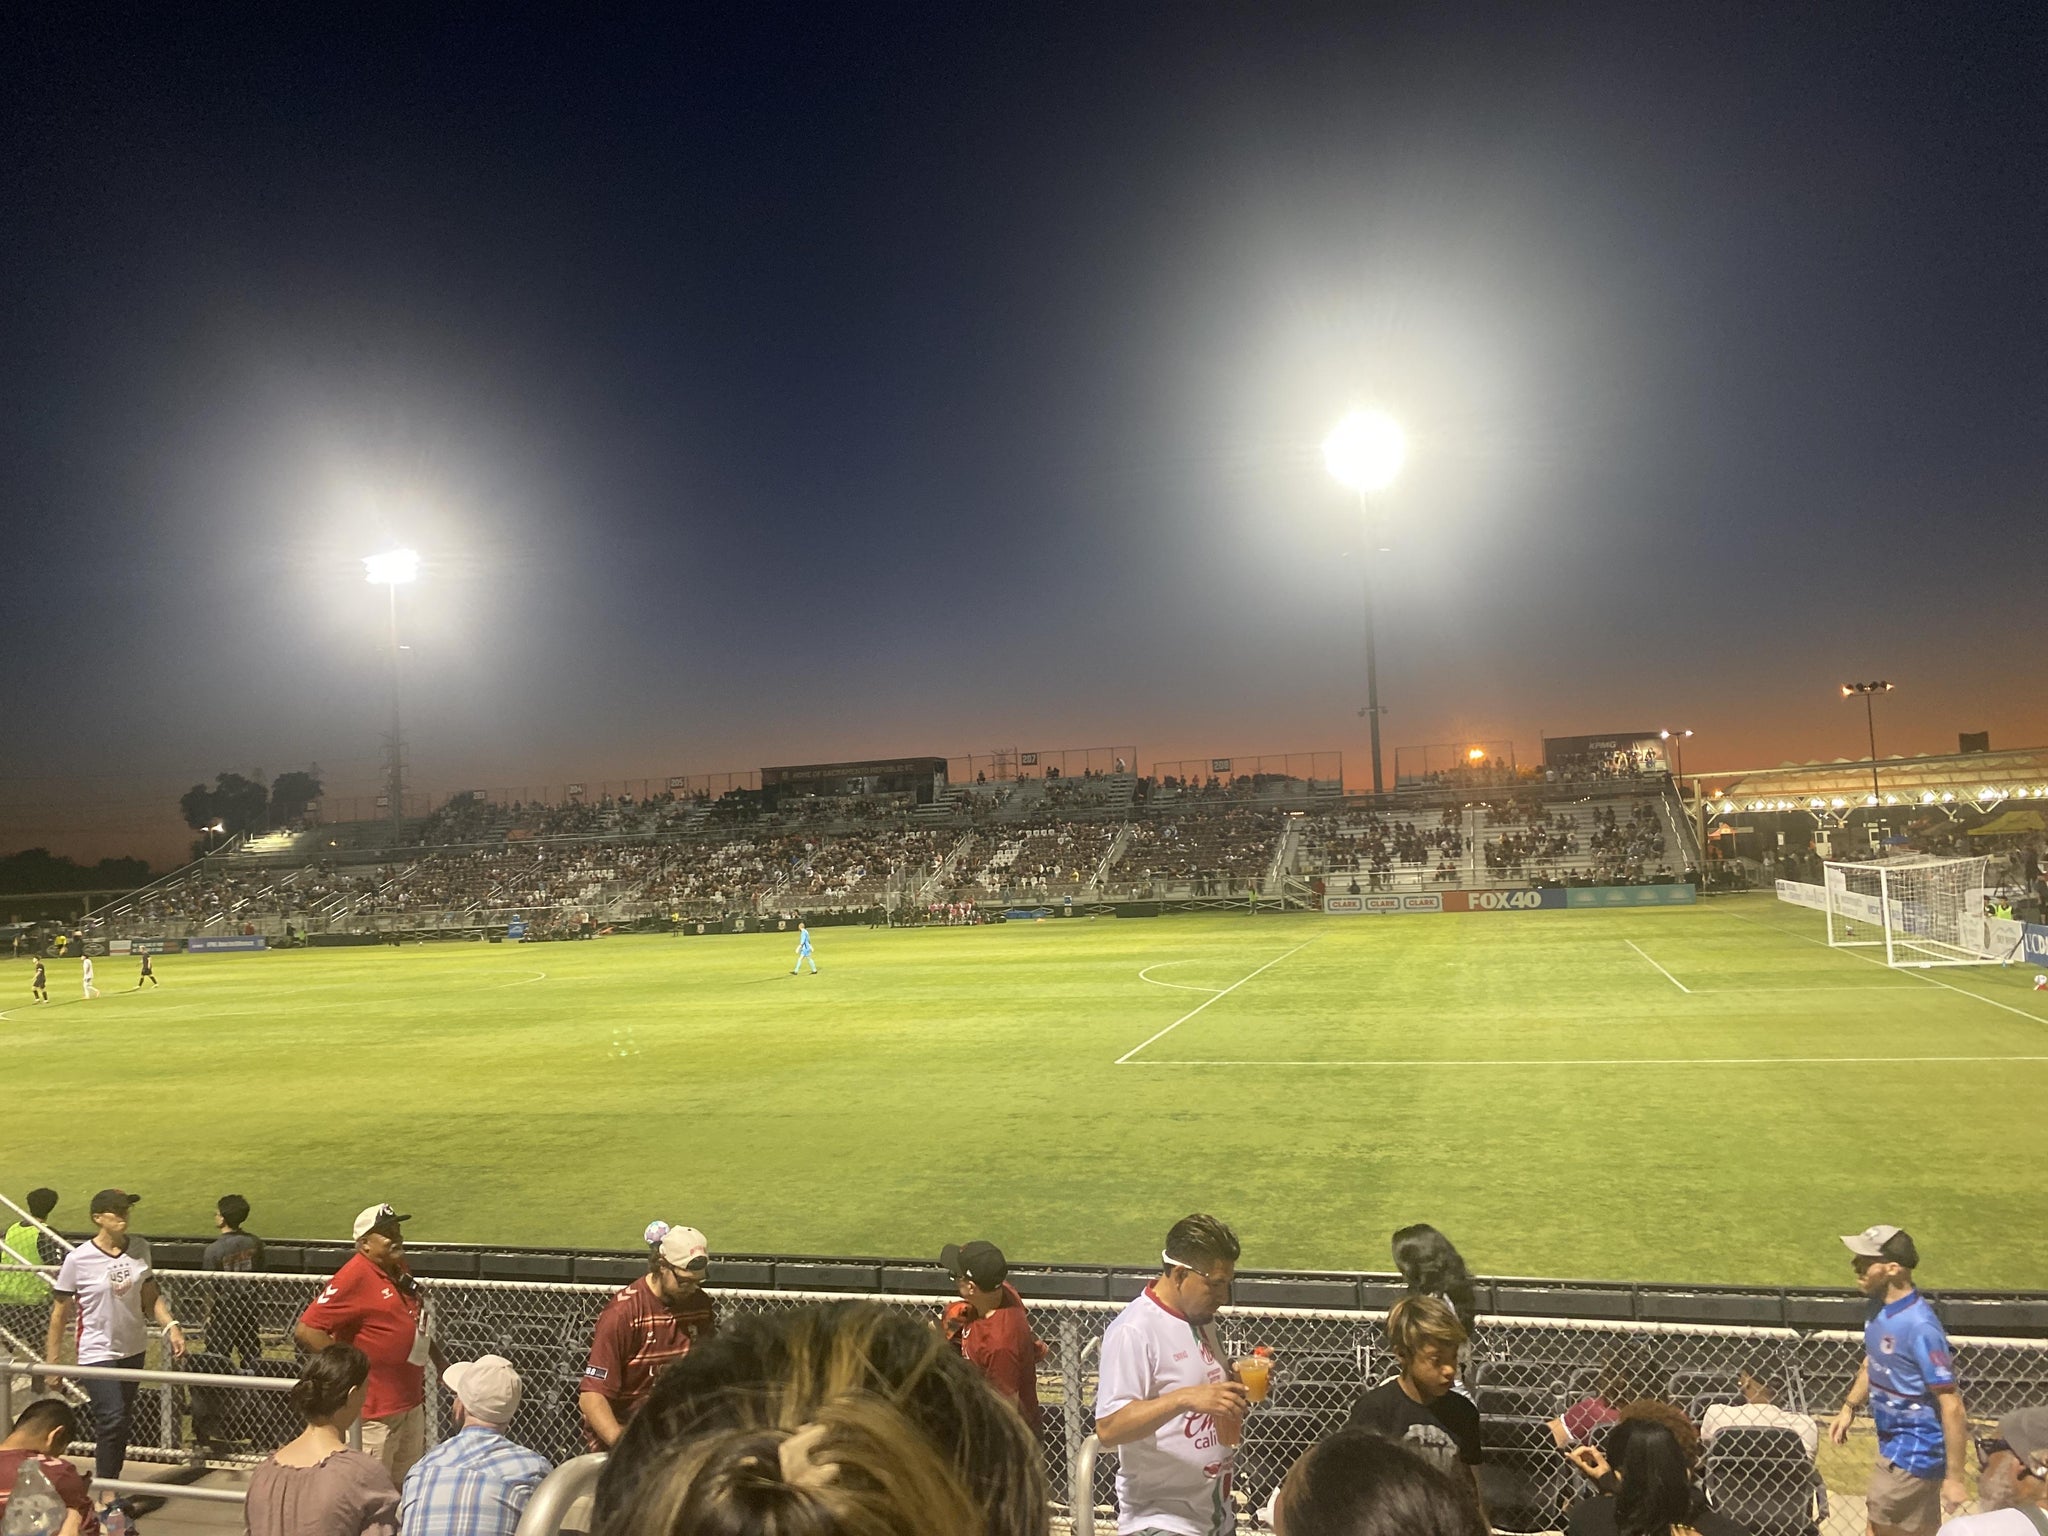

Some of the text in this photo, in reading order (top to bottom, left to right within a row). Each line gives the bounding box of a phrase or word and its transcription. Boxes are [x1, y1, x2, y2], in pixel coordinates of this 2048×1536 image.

[1589, 741, 1617, 750] KPMG
[1022, 754, 1036, 764] 207
[812, 770, 821, 778] OF
[823, 767, 869, 778] SACRAMENTO
[1468, 891, 1541, 910] FOX40
[2024, 933, 2048, 956] UCD
[110, 1269, 131, 1283] USA
